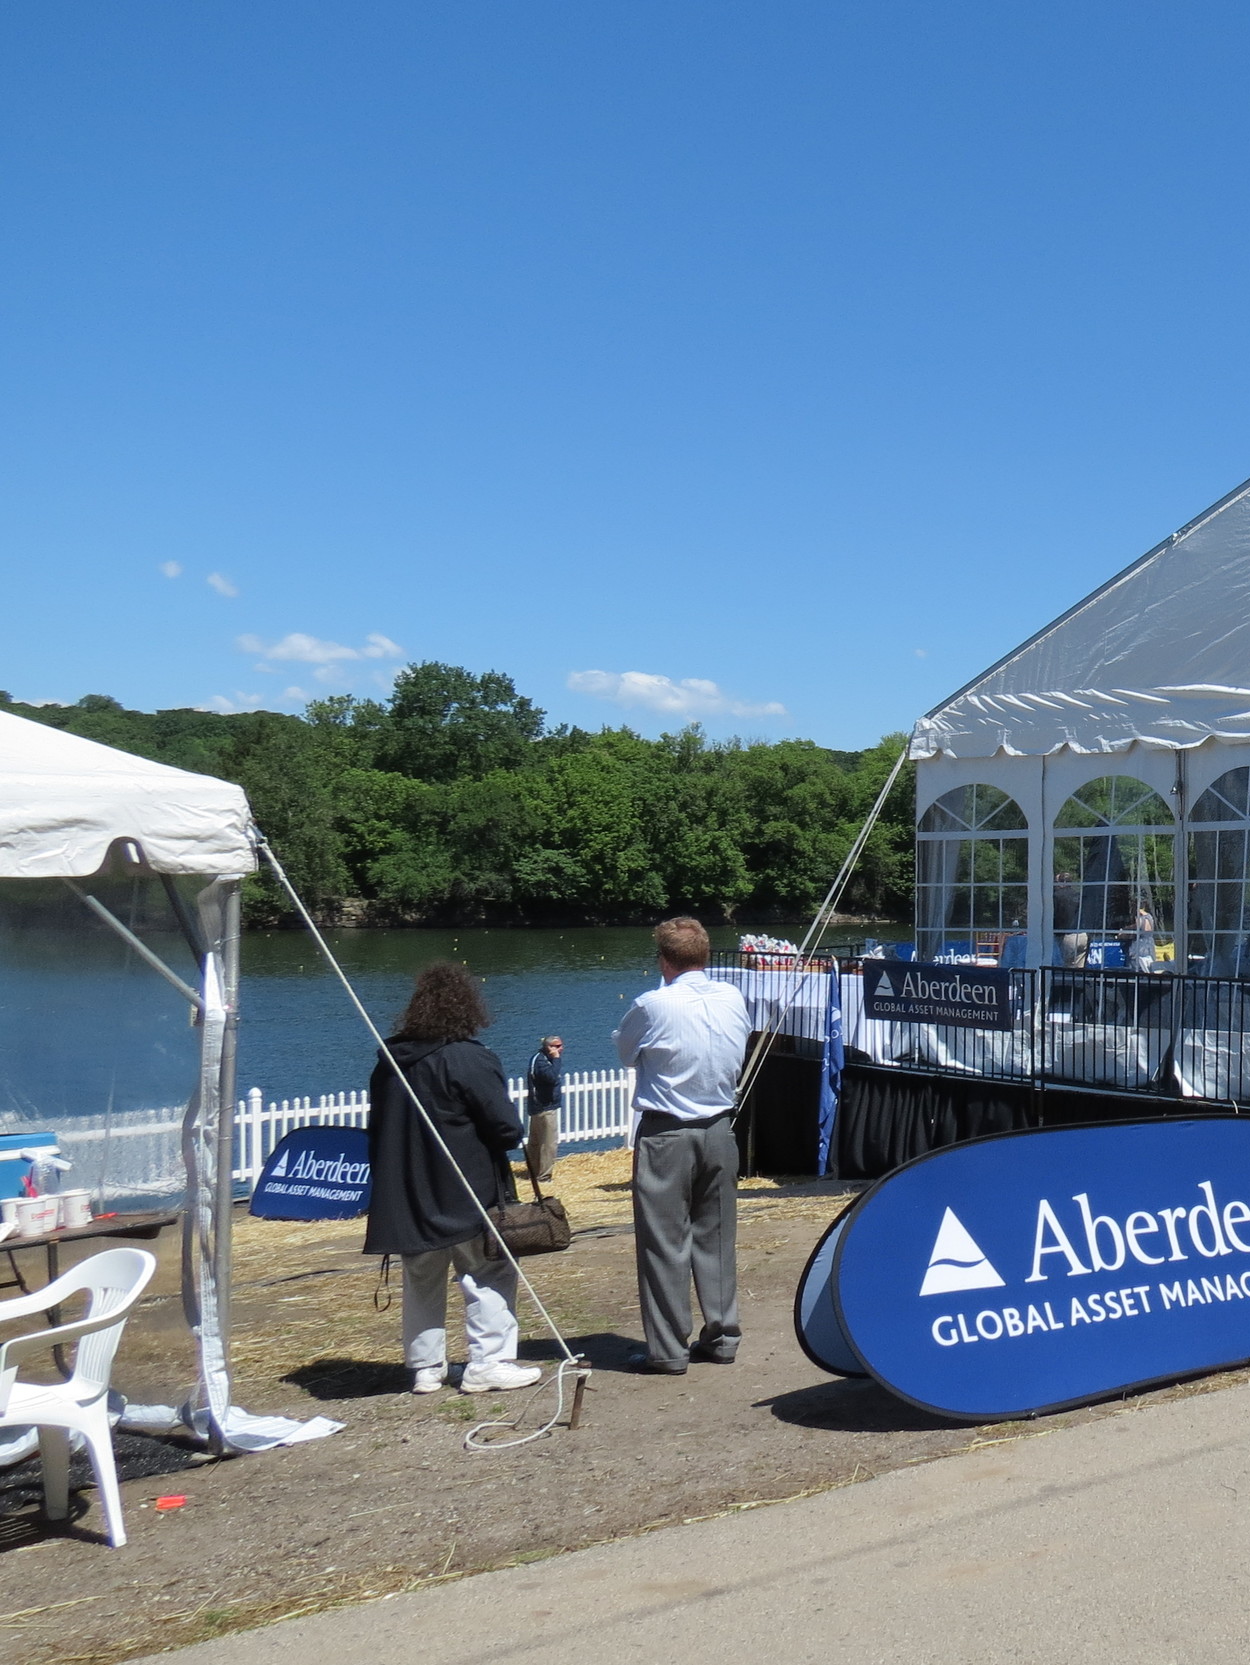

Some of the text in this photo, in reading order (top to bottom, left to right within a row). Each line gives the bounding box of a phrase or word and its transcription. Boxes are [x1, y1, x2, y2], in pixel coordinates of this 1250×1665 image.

[900, 971, 998, 1006] Aberdeen
[873, 1001, 999, 1021] GLOBAL ASSET MANAGEMENT
[288, 1150, 371, 1184] Aberdeen
[264, 1182, 363, 1201] GLOBAL ASSET MANAGEMENT
[931, 1302, 1064, 1347] GLOBAL
[1070, 1285, 1151, 1326] ASSET
